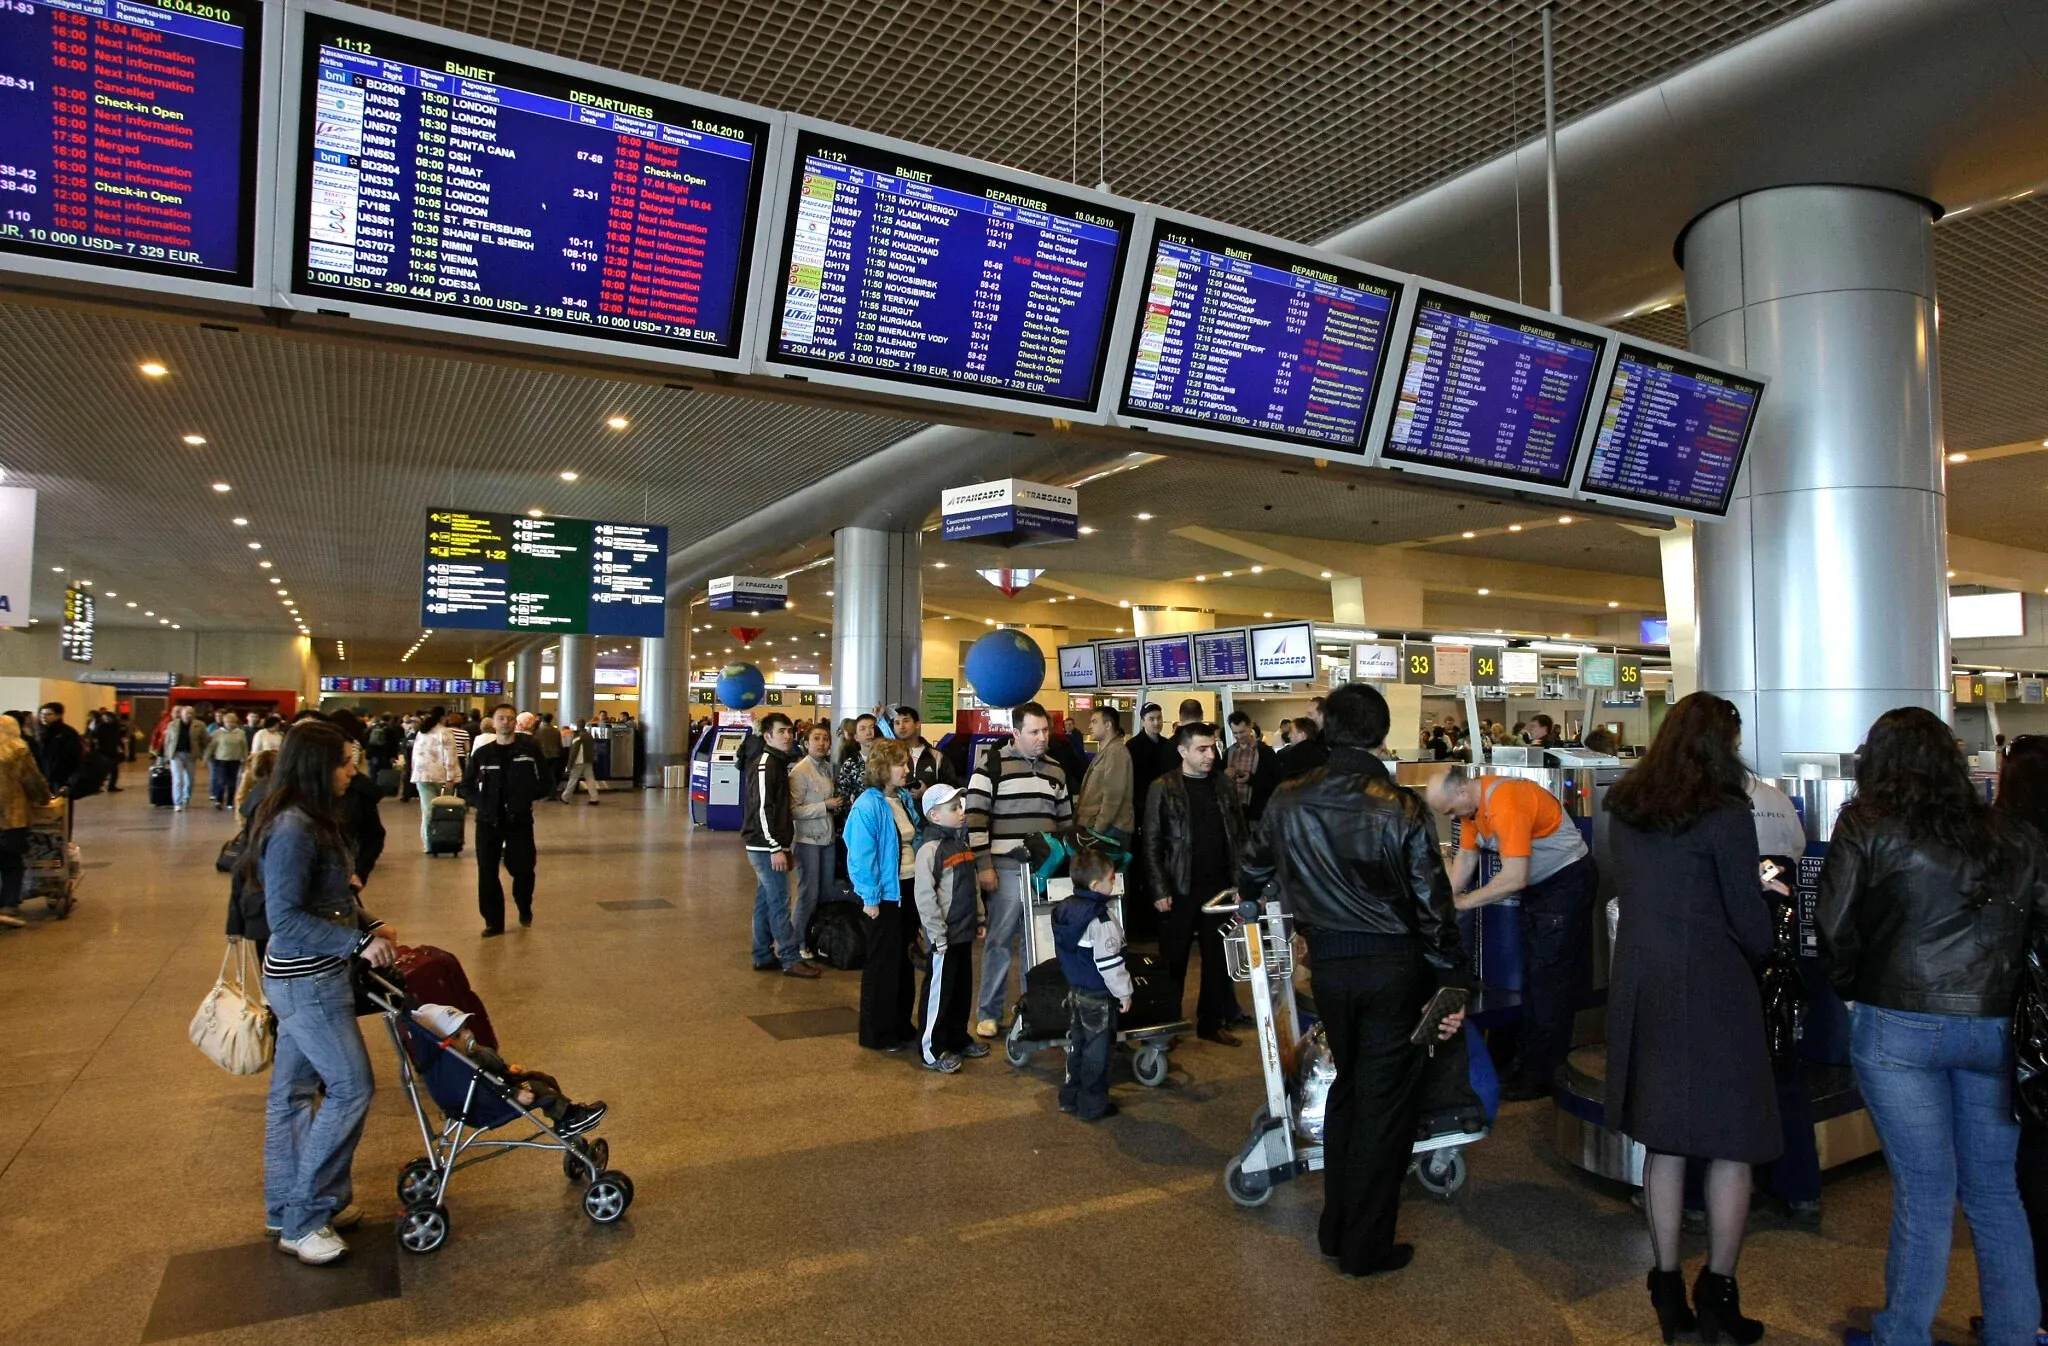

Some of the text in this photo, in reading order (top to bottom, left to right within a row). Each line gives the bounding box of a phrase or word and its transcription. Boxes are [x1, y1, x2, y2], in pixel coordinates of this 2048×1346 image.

[116, 11, 154, 26] Remarks
[131, 28, 161, 41] flight
[95, 35, 194, 63] Next information
[333, 37, 370, 55] 11:12
[445, 61, 495, 82] ВЫЛЕТ
[94, 79, 154, 99] Cancelled
[94, 94, 148, 113] Check-in
[151, 106, 183, 120] Open
[325, 69, 678, 154] bmi BD2906 15:00 LONDON Merged
[569, 90, 652, 118] DEPARTURES
[461, 88, 499, 102] Destination
[662, 133, 688, 145] Remarks
[691, 119, 743, 139] 18.04.2010
[94, 138, 139, 154] Merged
[416, 143, 471, 162] 01:20 OSH
[419, 117, 706, 185] 15:30 BISHKEK 67-68 Check-in Open
[449, 137, 488, 152] PUNTA
[487, 145, 515, 158] CANA
[818, 149, 842, 162] 11:12
[415, 157, 598, 200] 08:00 RABAT 23-31
[895, 166, 932, 182] ВЫЛЕТ
[0, 164, 181, 204] 38-42 Check-in Open
[985, 188, 1047, 211] DEPARTURES
[412, 209, 531, 237] 10:15 ST. PETERSBURG
[876, 191, 896, 202] 11:15
[898, 196, 920, 207] NOVY
[922, 202, 957, 216] URENGOJ
[1040, 230, 1055, 239] Gate
[1056, 234, 1078, 245] Closed
[897, 207, 949, 226] VLADIKAVKAZ
[1075, 211, 1113, 227] 18.04.2010
[7, 210, 190, 245] 110 Next information
[871, 224, 939, 245] 11:40 FRANKFURT
[29, 228, 202, 263] 10 000 USD= 7 329 EUR.
[442, 227, 597, 261] SHARM EL SHEIKH 108-110
[895, 219, 1087, 267] AQABA Check-in Closed
[1167, 233, 1186, 245] 11:12
[1225, 247, 1252, 260] ВЫЛЕТ
[1291, 265, 1337, 283] DEPARTURES
[385, 282, 456, 302] 290 444 руб
[438, 277, 587, 307] ODESSA 38-40
[886, 272, 937, 288] NOVOSIBIRSK
[1027, 300, 1036, 308] Go
[1045, 304, 1060, 313] Gate
[1223, 282, 1247, 293] САМАРА
[883, 293, 919, 306] YEREVAN
[1221, 291, 1256, 304] КРАСНОДАР
[881, 304, 913, 316] SURGUT
[1218, 310, 1271, 326] САНКТ-ПЕТЕРБУРГ
[1216, 319, 1251, 332] ФРАНКФУРТ
[1520, 324, 1554, 339] DEPARTURES
[875, 346, 915, 358] TASHKENT
[878, 325, 926, 340] MINERALNYE
[928, 334, 948, 343] VODY
[970, 341, 988, 350] 12-14
[1018, 350, 1045, 361] Check-in
[1046, 355, 1063, 364] Open
[1026, 490, 1072, 505] TRANSAERO
[485, 550, 506, 560] 1-22
[1259, 656, 1306, 666] TRANSAERO
[1411, 655, 1429, 674] 33
[1478, 658, 1494, 676] 34
[1064, 669, 1094, 678] TRANSAERO
[1621, 666, 1637, 682] 35
[702, 692, 712, 700] 12
[769, 693, 779, 701] 13
[804, 694, 813, 702] 14
[1974, 684, 1983, 696] 40
